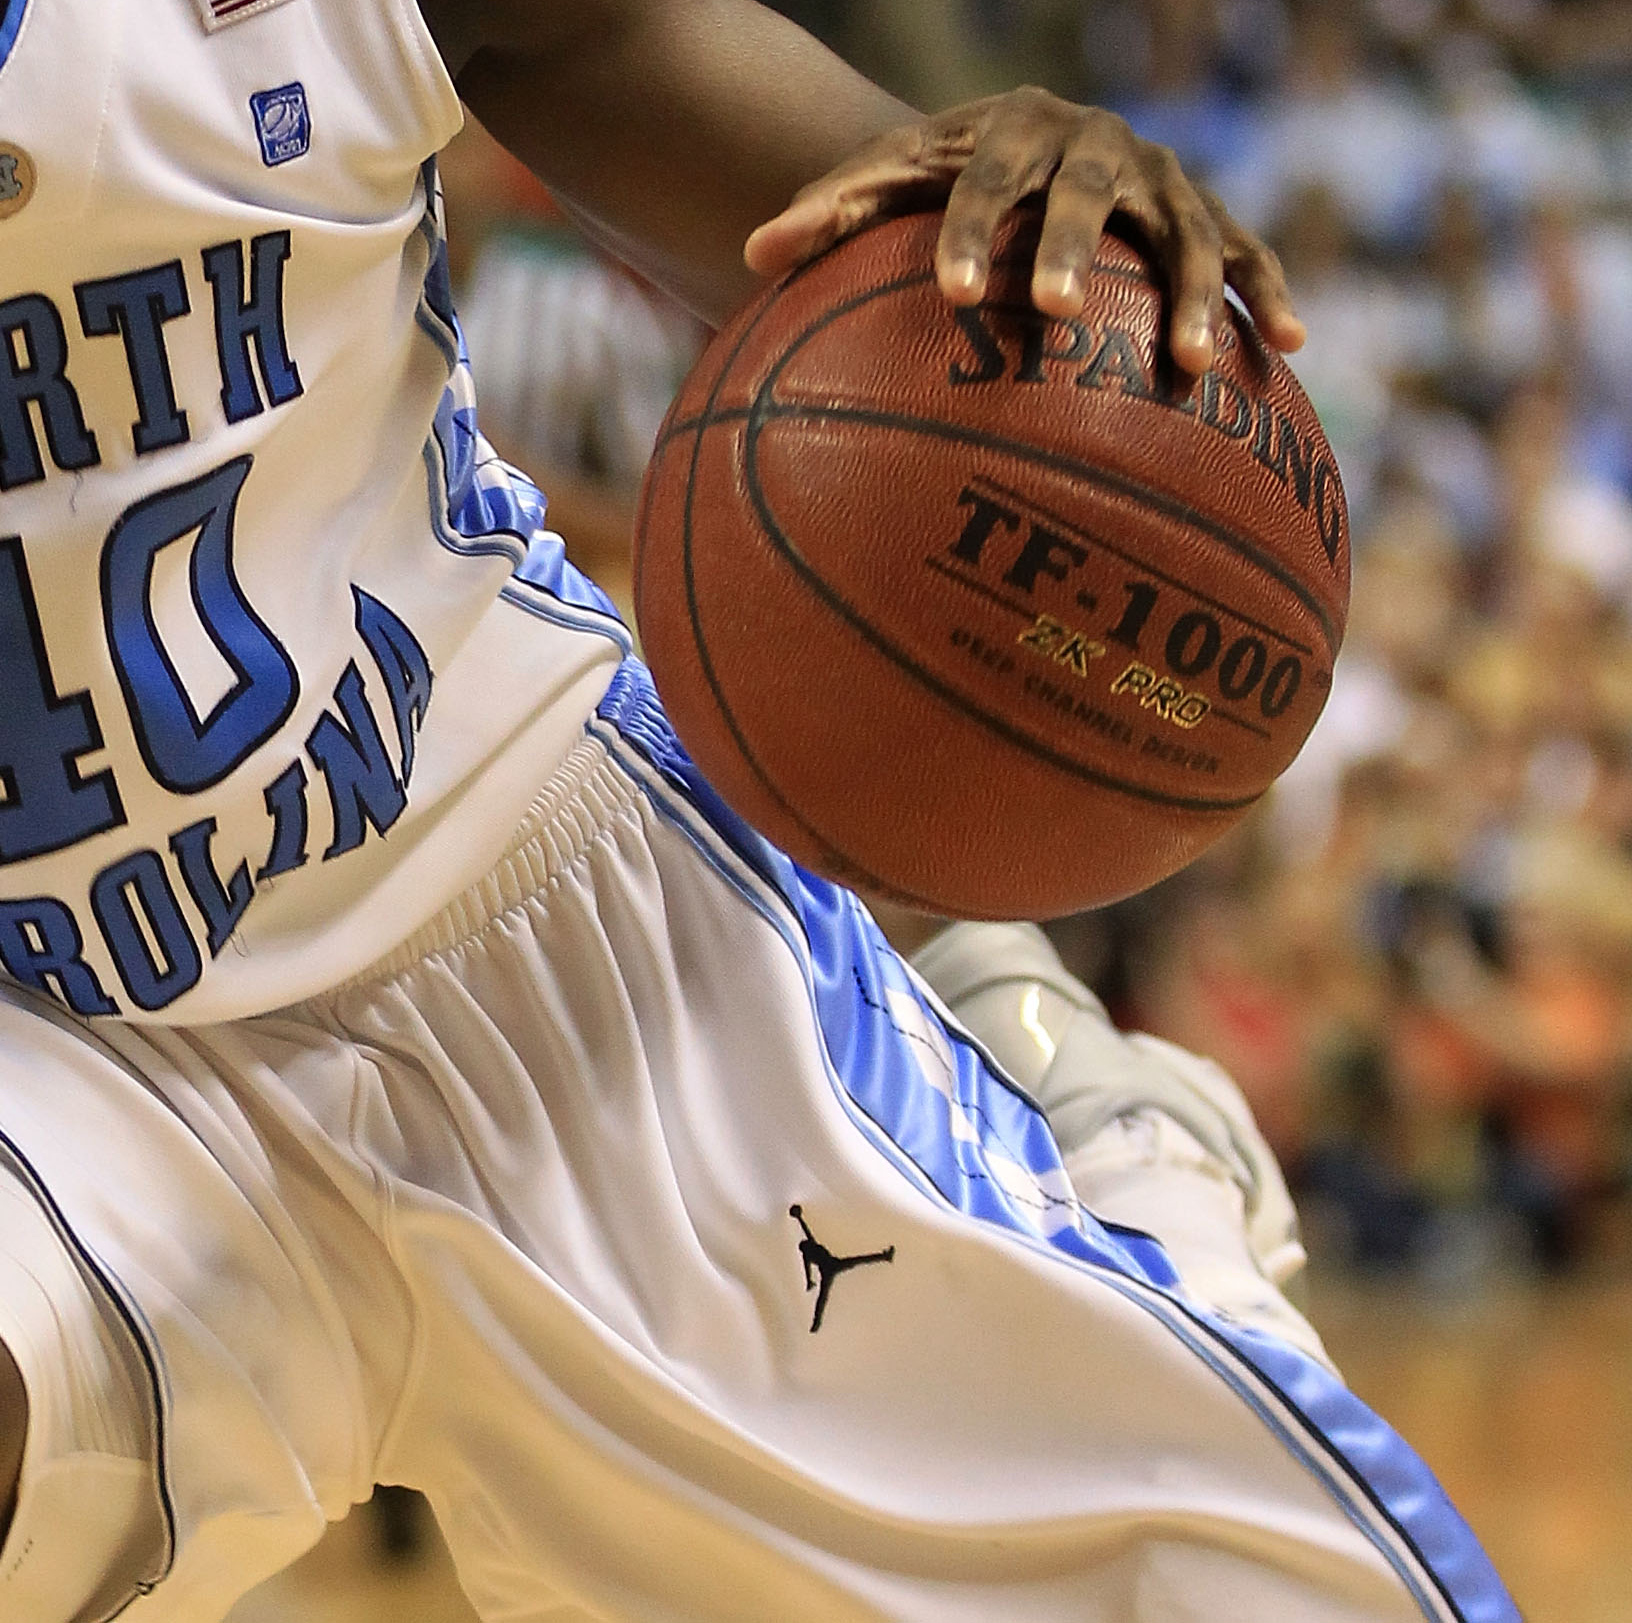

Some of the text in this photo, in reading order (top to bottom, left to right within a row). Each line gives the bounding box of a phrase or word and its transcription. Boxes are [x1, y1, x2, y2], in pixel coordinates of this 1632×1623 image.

[948, 305, 1341, 566] SPADING
[950, 485, 1302, 719] TF-1000
[1110, 660, 1212, 729] PRO
